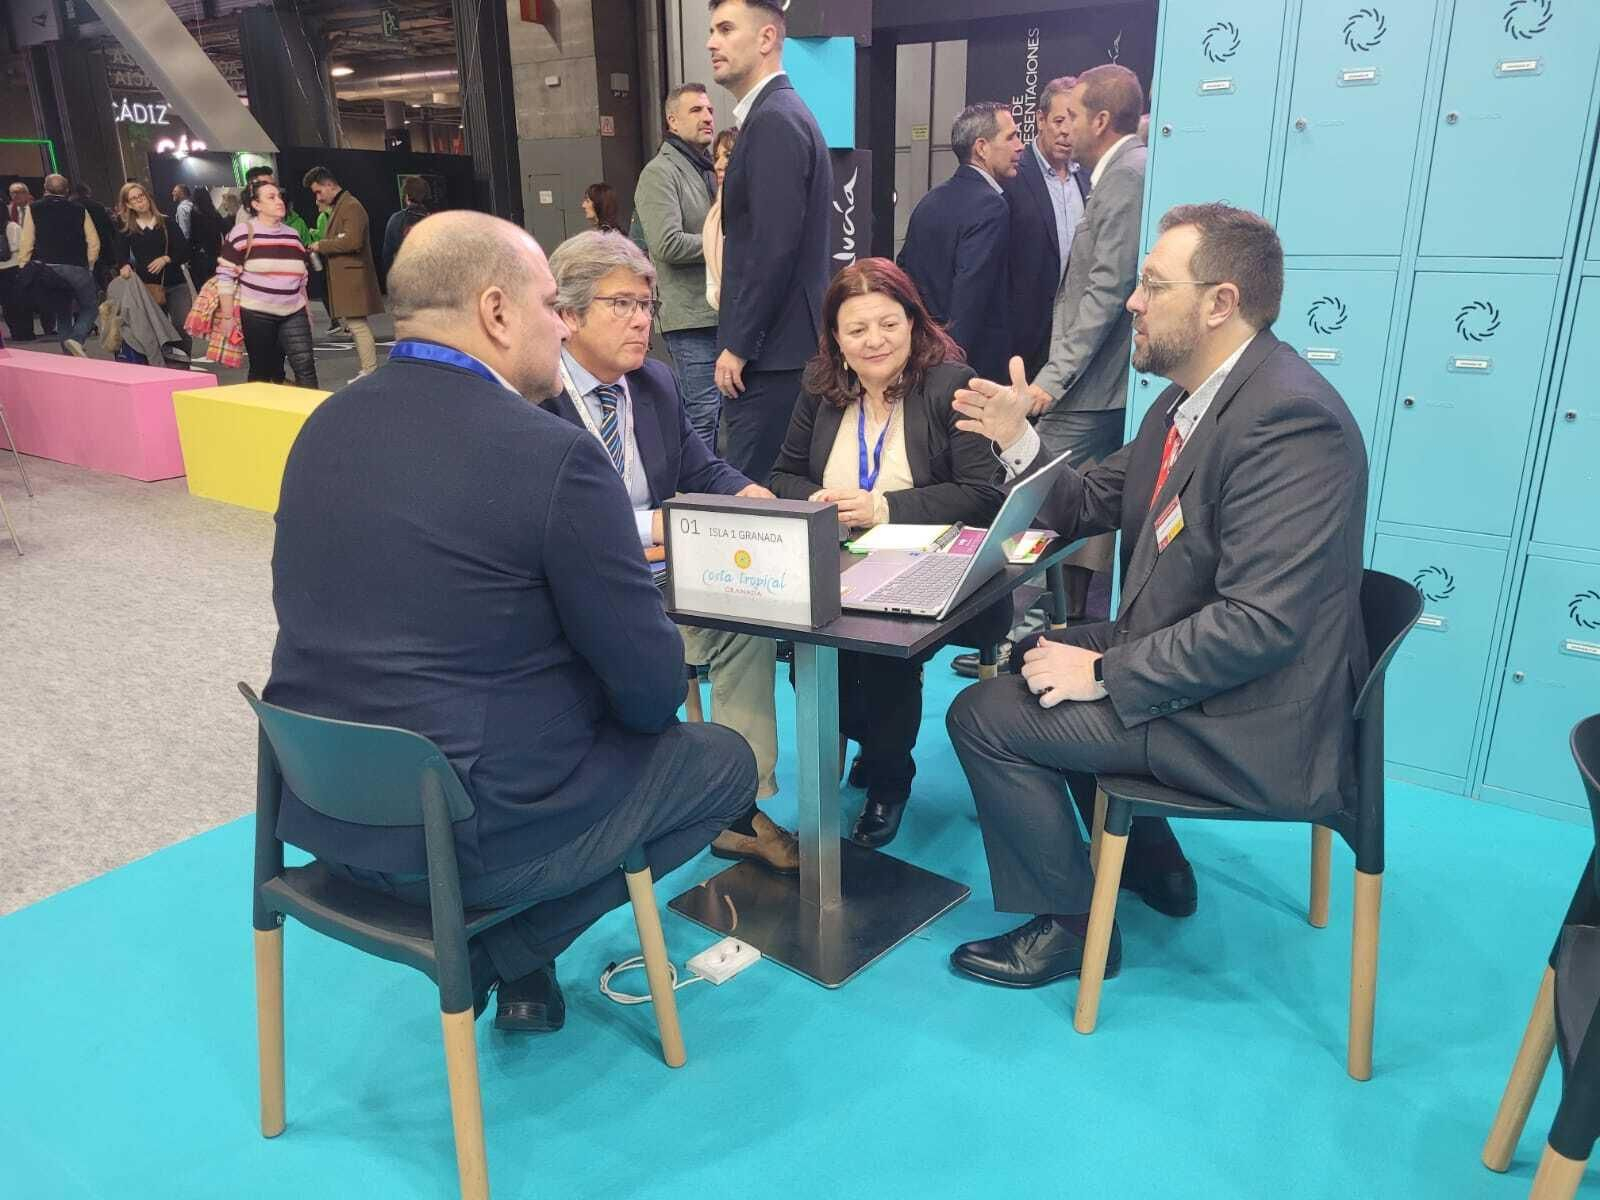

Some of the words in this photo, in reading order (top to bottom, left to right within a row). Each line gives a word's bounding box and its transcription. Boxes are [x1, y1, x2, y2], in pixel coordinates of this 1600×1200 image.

[1024, 27, 1040, 146] ESENTACIONES
[1012, 95, 1024, 116] DE
[680, 518, 701, 535] 01
[709, 527, 729, 538] ISLA
[731, 530, 736, 539] 1
[738, 530, 783, 543] GRANADA
